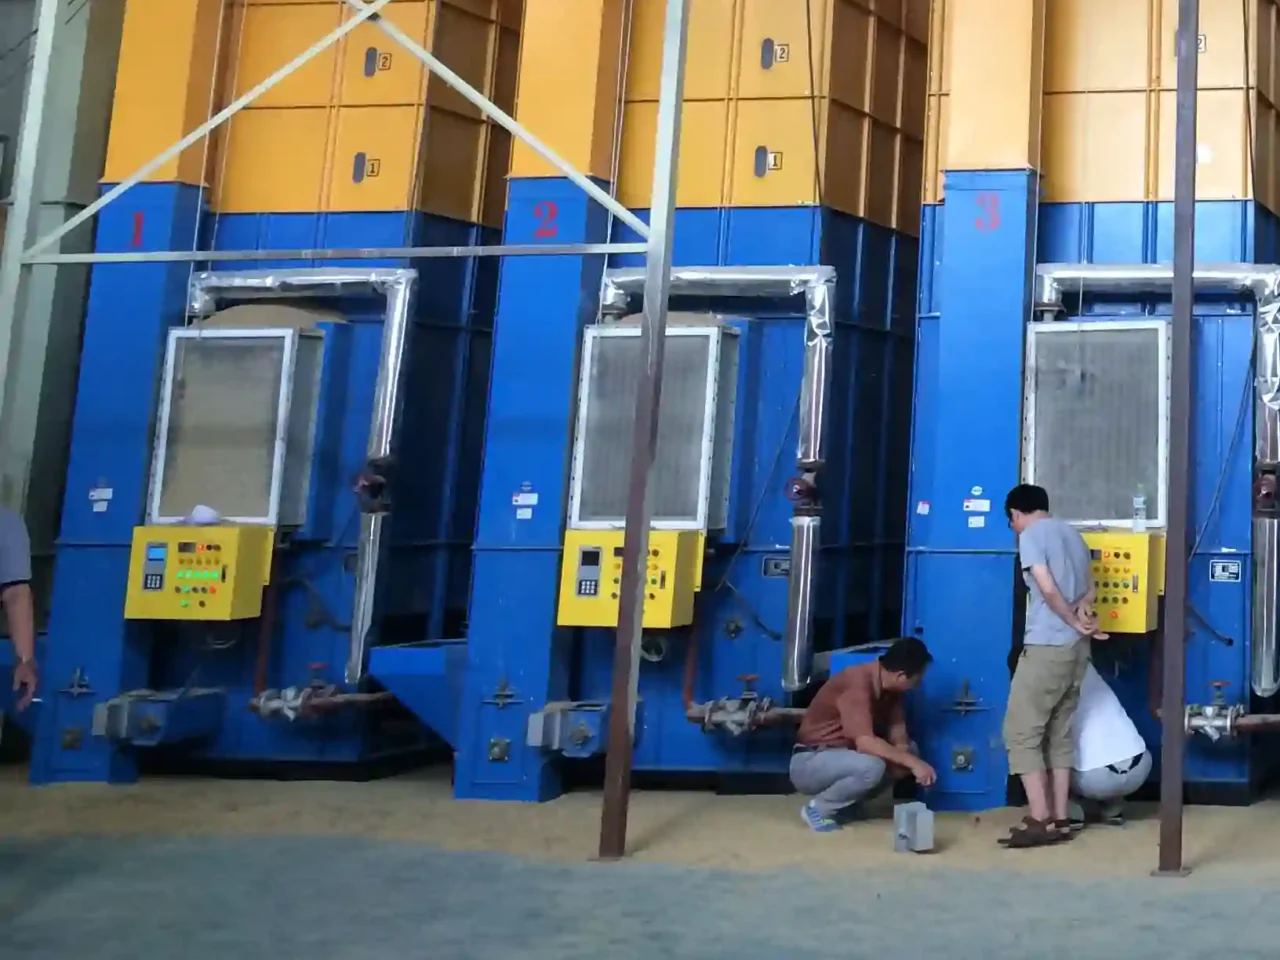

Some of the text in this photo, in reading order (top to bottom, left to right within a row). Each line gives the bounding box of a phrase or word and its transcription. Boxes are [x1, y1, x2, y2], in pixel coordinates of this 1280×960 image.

[131, 211, 145, 247] 1
[533, 200, 559, 238] 2
[974, 191, 1001, 232] 3
